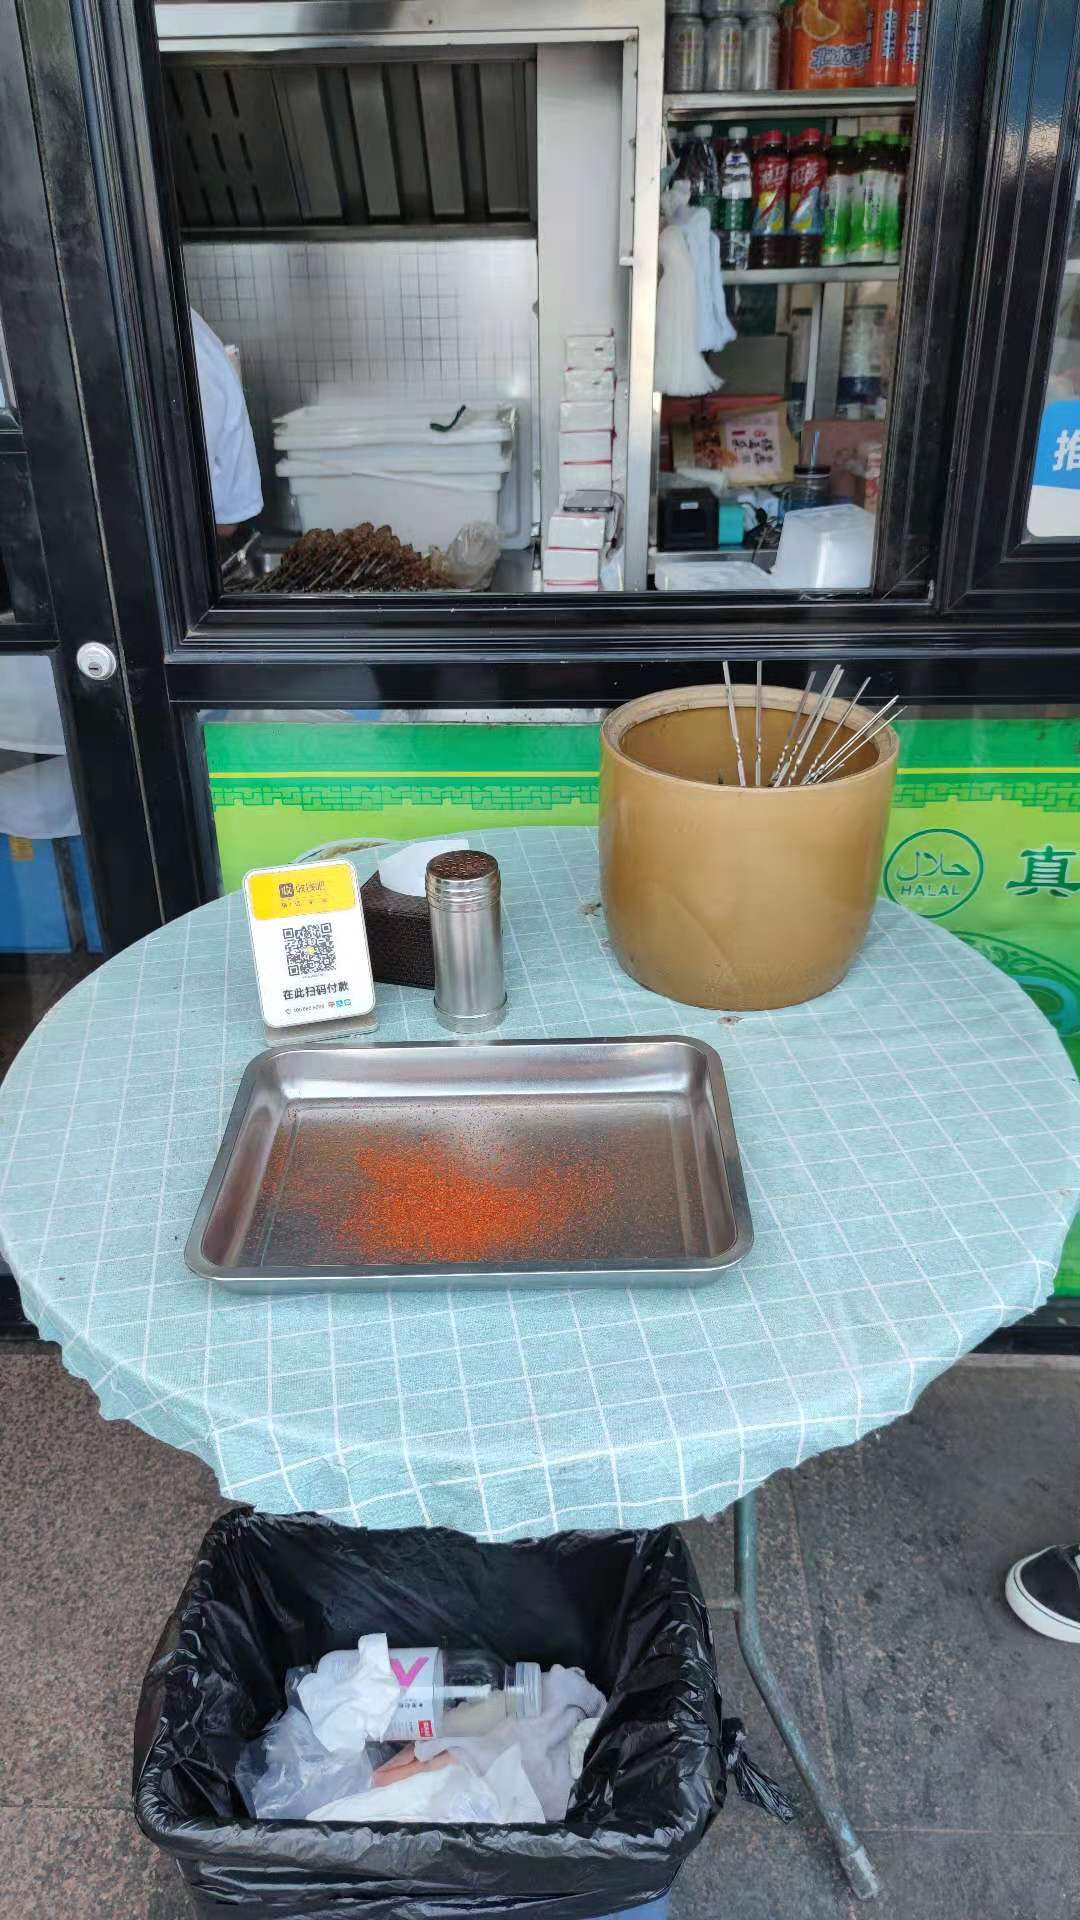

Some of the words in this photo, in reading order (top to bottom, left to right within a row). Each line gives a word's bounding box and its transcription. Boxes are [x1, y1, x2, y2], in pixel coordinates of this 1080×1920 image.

[896, 851, 971, 882] حلال
[1006, 845, 1080, 897] 真
[900, 884, 961, 897] HALAL
[283, 980, 349, 1000] 在此扫码付款
